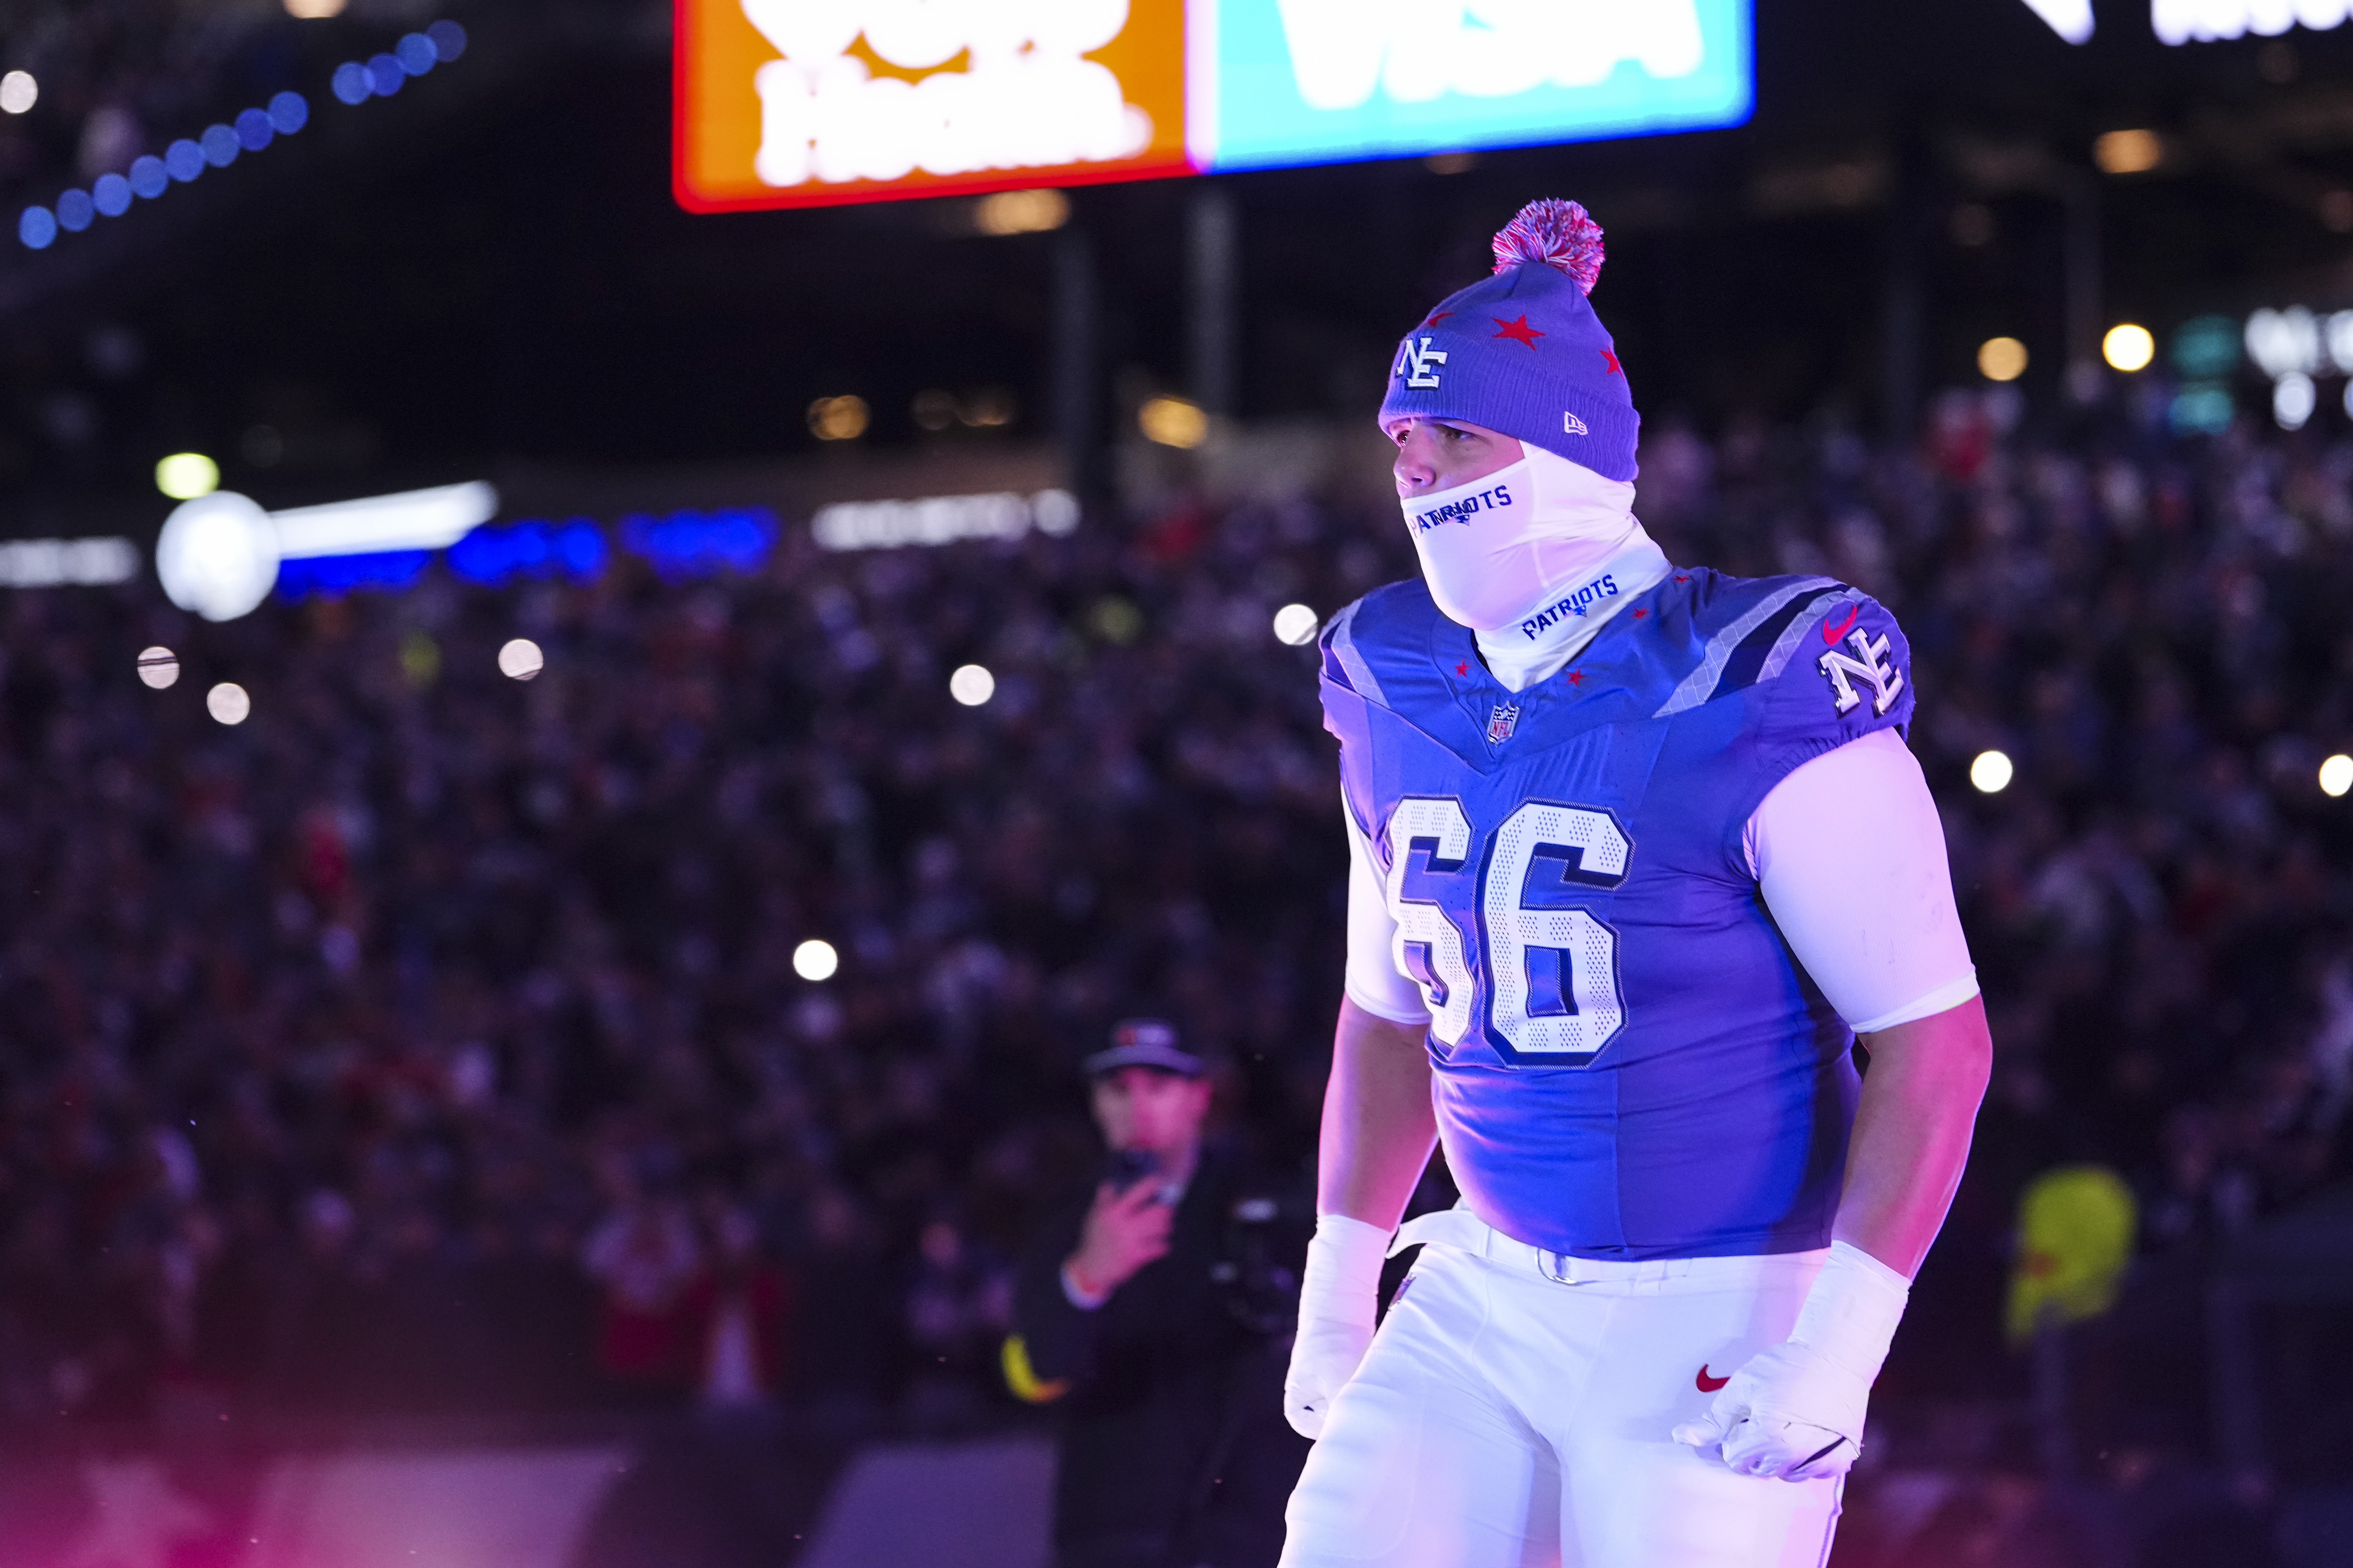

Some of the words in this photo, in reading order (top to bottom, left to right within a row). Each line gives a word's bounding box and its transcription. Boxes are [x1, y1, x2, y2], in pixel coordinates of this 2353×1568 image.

[1395, 336, 1448, 390] NE
[1408, 485, 1512, 538] PATRIOTS
[1522, 574, 1618, 641] PATRIOTS
[1815, 626, 1904, 720] NE
[1386, 794, 1636, 1069] 66
